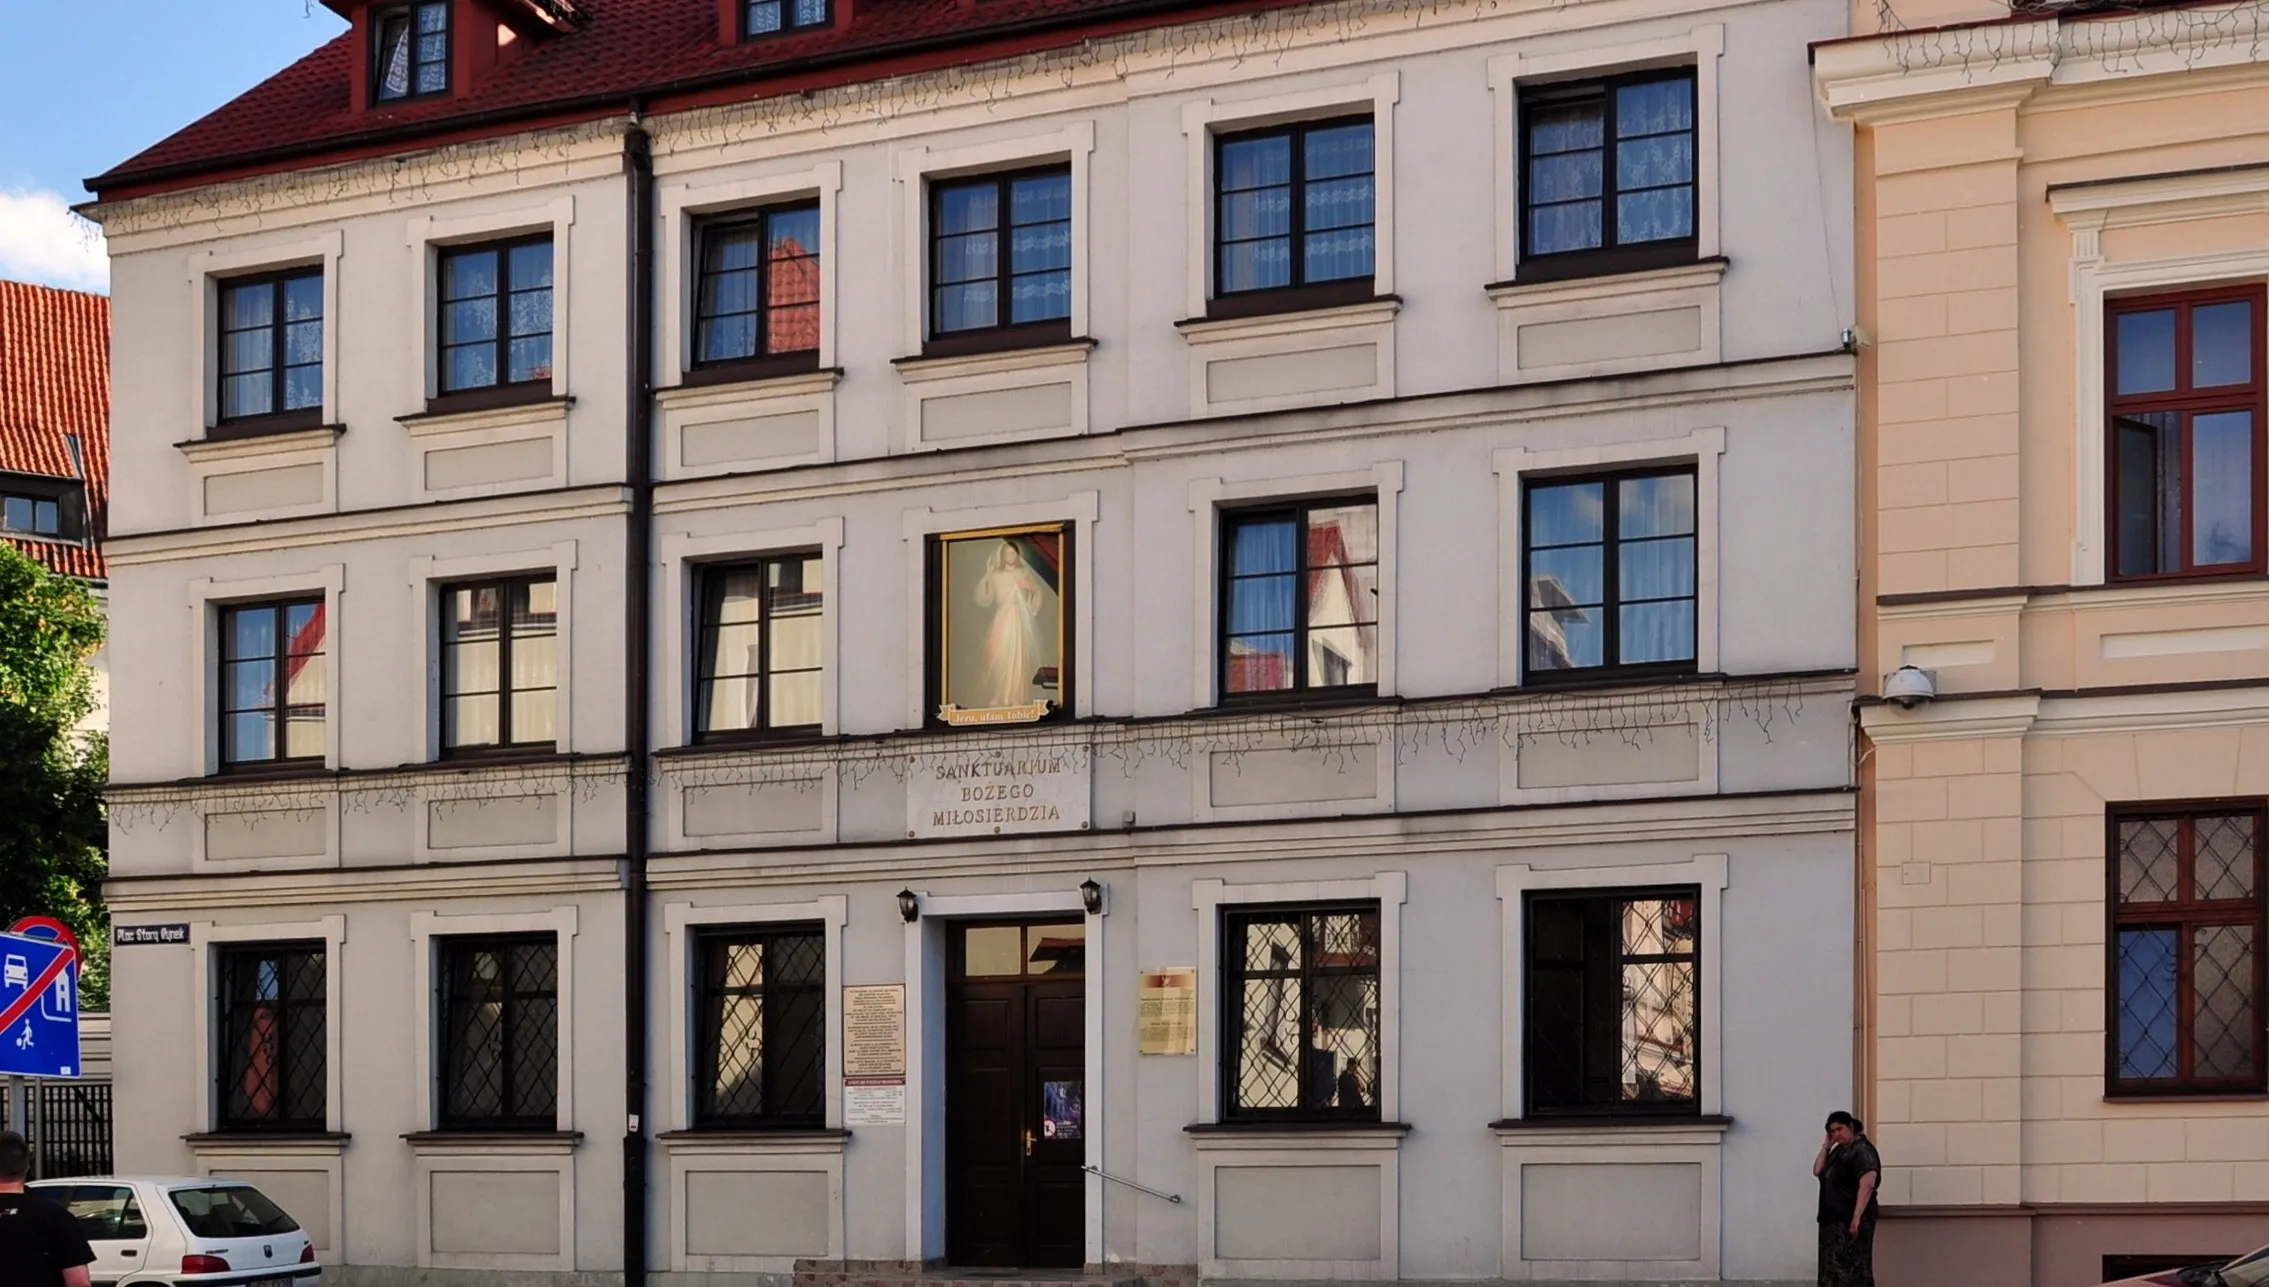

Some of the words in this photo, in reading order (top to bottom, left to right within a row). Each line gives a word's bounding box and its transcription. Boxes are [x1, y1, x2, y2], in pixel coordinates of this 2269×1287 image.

[955, 713, 978, 723] Jezu,
[980, 712, 1004, 722] ufam
[1007, 710, 1035, 721] Tobie!
[936, 758, 1061, 780] SANKTUARIUM
[961, 782, 1034, 802] BOŻEGO
[933, 805, 1060, 826] MIŁOSIERDZIA
[117, 928, 135, 942] Plac
[136, 928, 159, 942] Stary
[160, 927, 185, 942] Rynek
